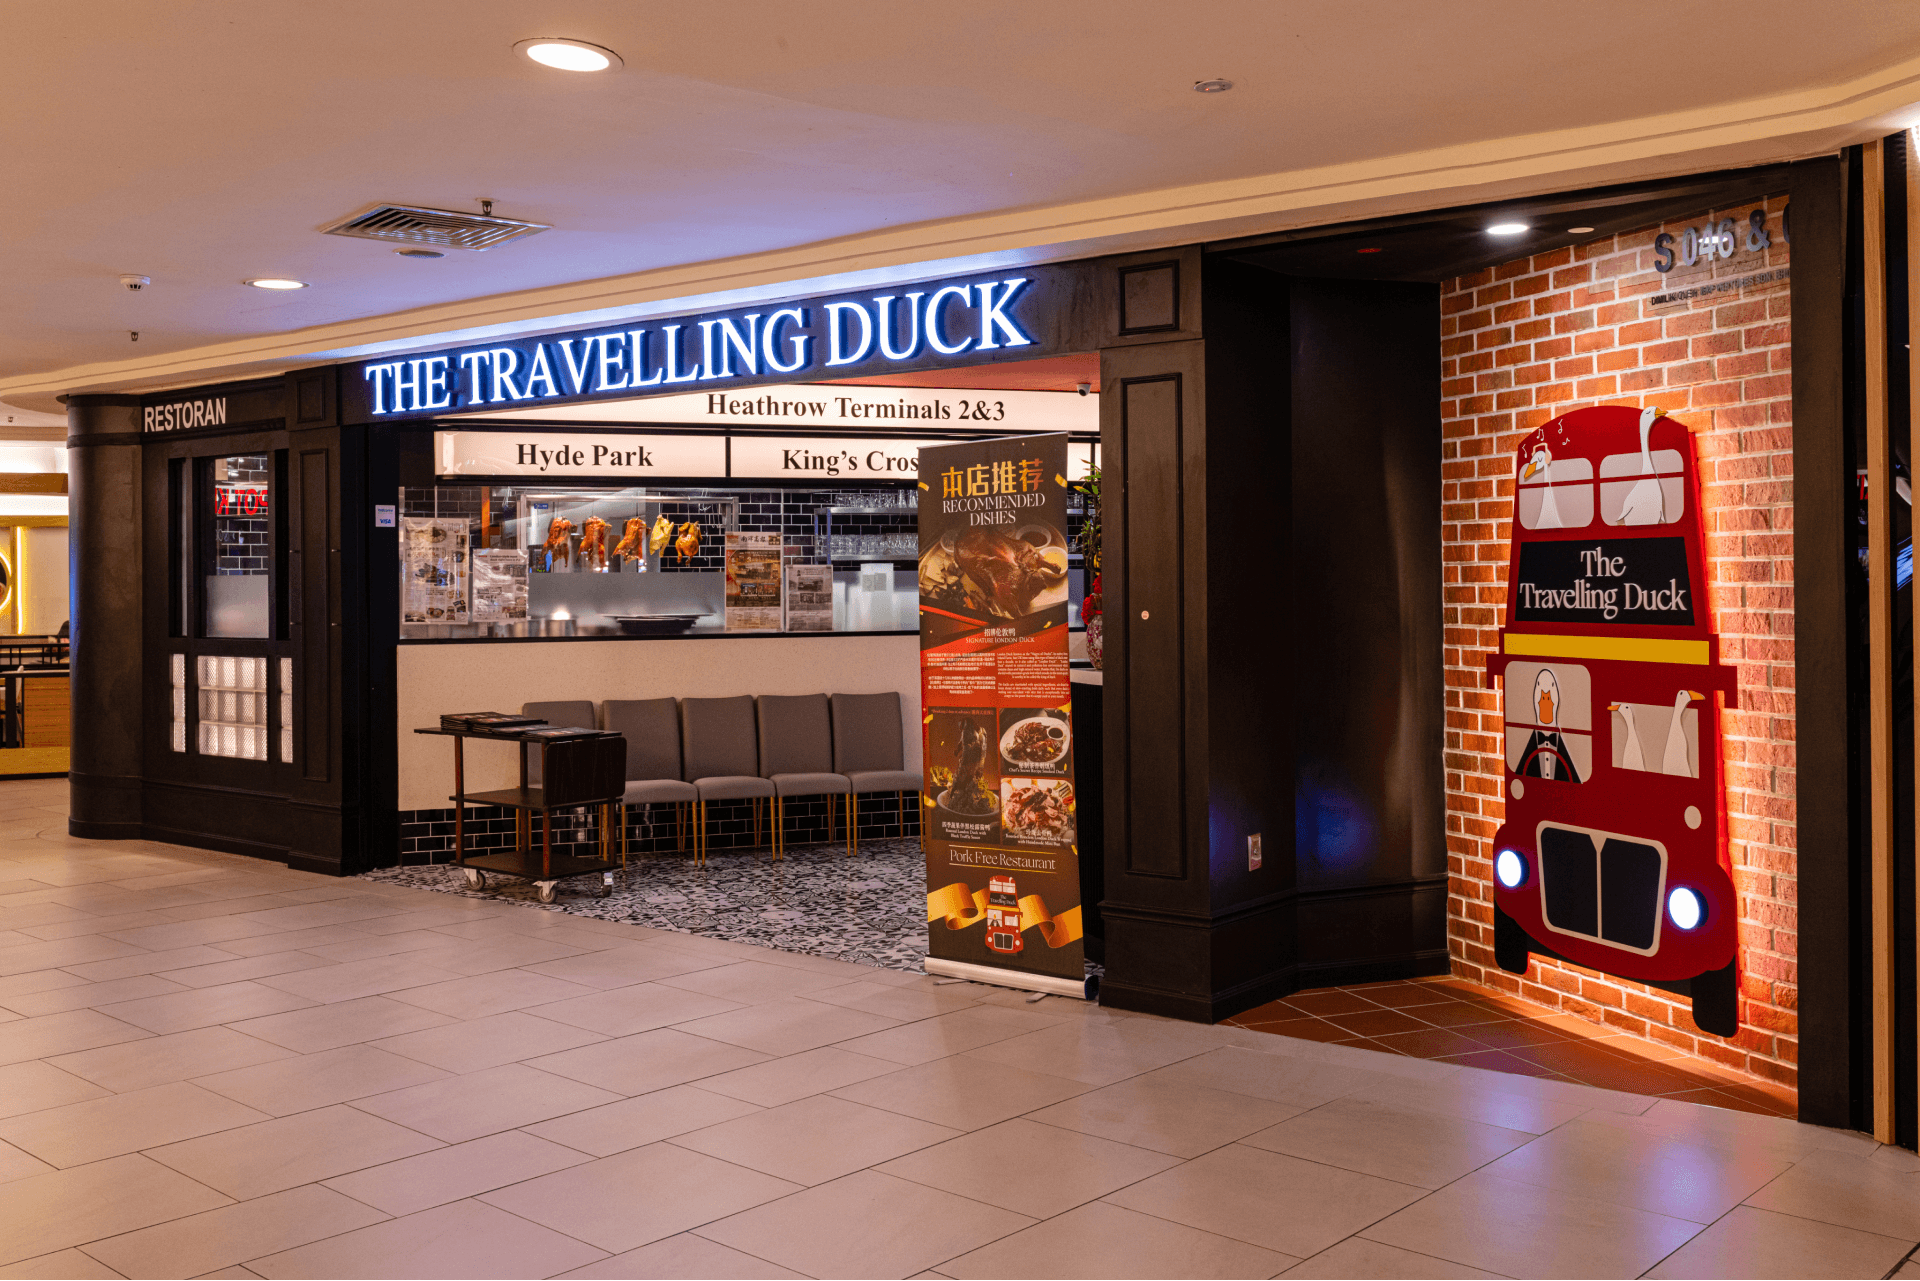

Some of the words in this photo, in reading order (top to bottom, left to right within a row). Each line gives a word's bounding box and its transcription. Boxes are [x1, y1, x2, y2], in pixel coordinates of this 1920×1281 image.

[1654, 233, 1672, 273] S
[1682, 218, 1734, 266] 046
[1746, 209, 1770, 252] &
[365, 355, 452, 416] THE
[460, 308, 809, 405] TRAVELLING
[824, 278, 1031, 367] DUCK
[144, 398, 226, 433] RESTORAN
[706, 392, 826, 418] Heathrow
[835, 396, 951, 421] Terminals
[959, 400, 1005, 423] 2&3
[516, 443, 583, 472] Hyde
[591, 443, 653, 467] Park
[782, 449, 858, 476] King's
[941, 458, 1044, 499] 本店推荐
[942, 493, 1046, 514] RECOMMENDED
[970, 510, 1016, 526] DISHES
[1580, 546, 1627, 577] The
[1519, 579, 1618, 620] Travelling
[1624, 578, 1687, 611] Duck
[950, 849, 973, 863] Pork
[975, 851, 999, 865] Free
[1000, 853, 1056, 870] Restaurant
